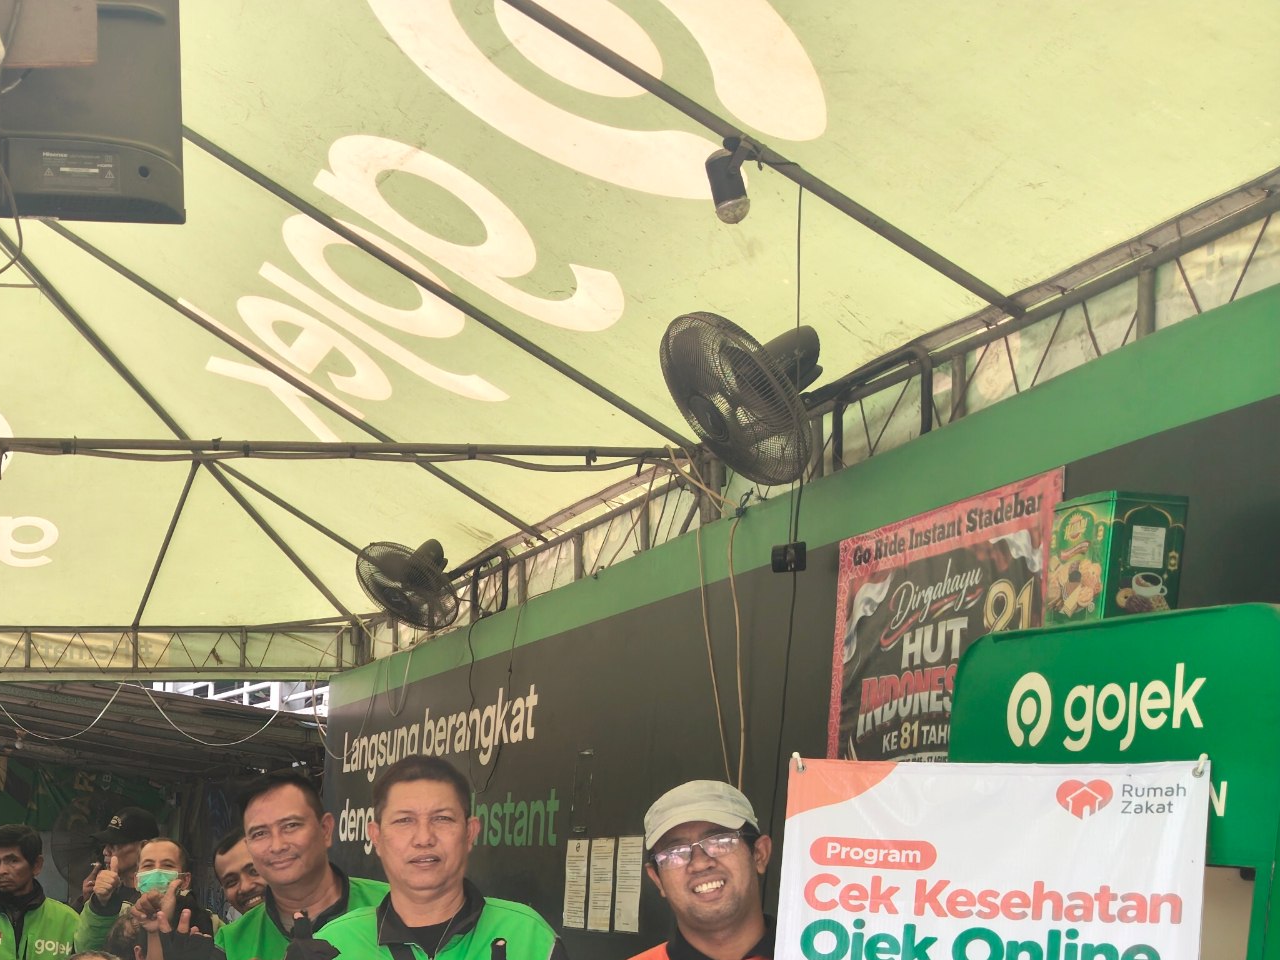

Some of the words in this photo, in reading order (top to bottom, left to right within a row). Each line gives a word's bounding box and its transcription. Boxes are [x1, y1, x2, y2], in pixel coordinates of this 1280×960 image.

[852, 545, 871, 567] Go
[874, 532, 906, 561] Ride
[908, 515, 963, 550] Instant
[889, 558, 983, 630] Dirgahayu
[901, 617, 968, 669] HUT
[422, 684, 538, 766] berangkat
[1063, 662, 1207, 752] gojek
[882, 731, 898, 753] KE
[900, 720, 919, 750] 81
[1120, 799, 1174, 815] Zakat
[1121, 783, 1187, 799] Rumah
[826, 841, 922, 866] Program
[803, 873, 901, 915] Cek
[914, 878, 1183, 925] Kesehatan
